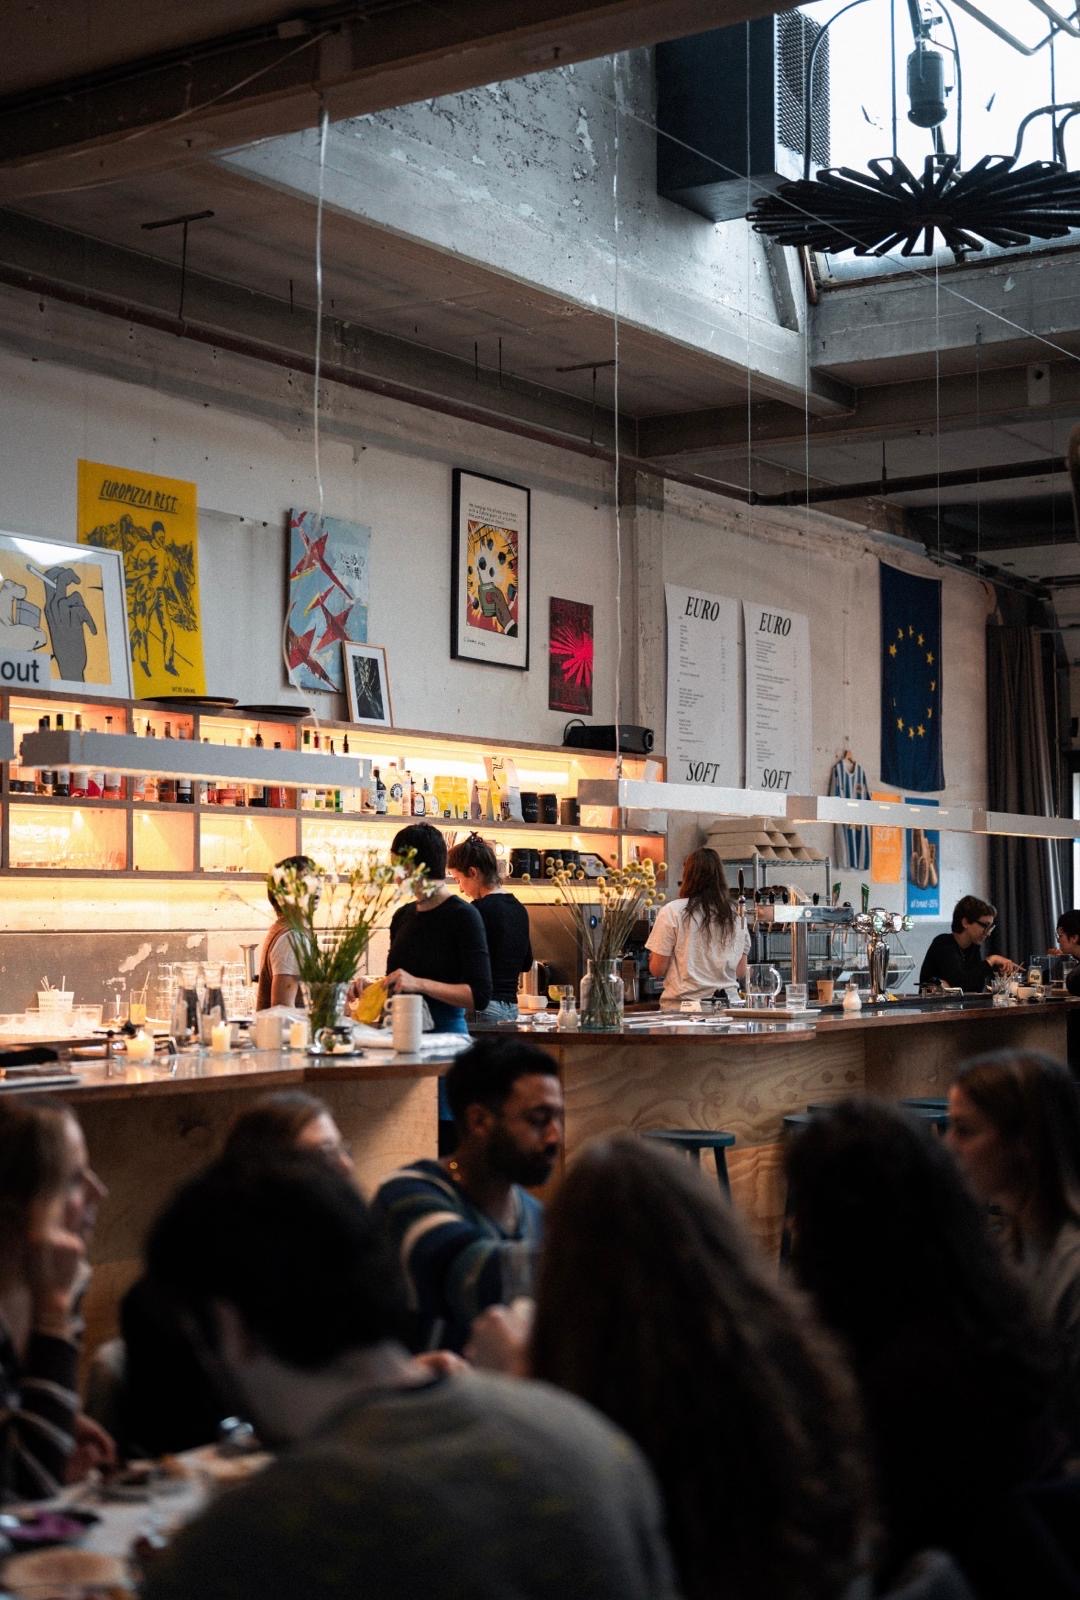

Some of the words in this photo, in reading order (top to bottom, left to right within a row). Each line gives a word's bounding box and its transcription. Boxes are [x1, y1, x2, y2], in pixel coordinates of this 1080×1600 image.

[100, 480, 152, 506] EUROPIZZA
[684, 596, 720, 622] EURO
[759, 612, 792, 637] EURO
[1, 659, 39, 683] out
[686, 761, 720, 783] SOFT
[761, 768, 792, 790] SOFT
